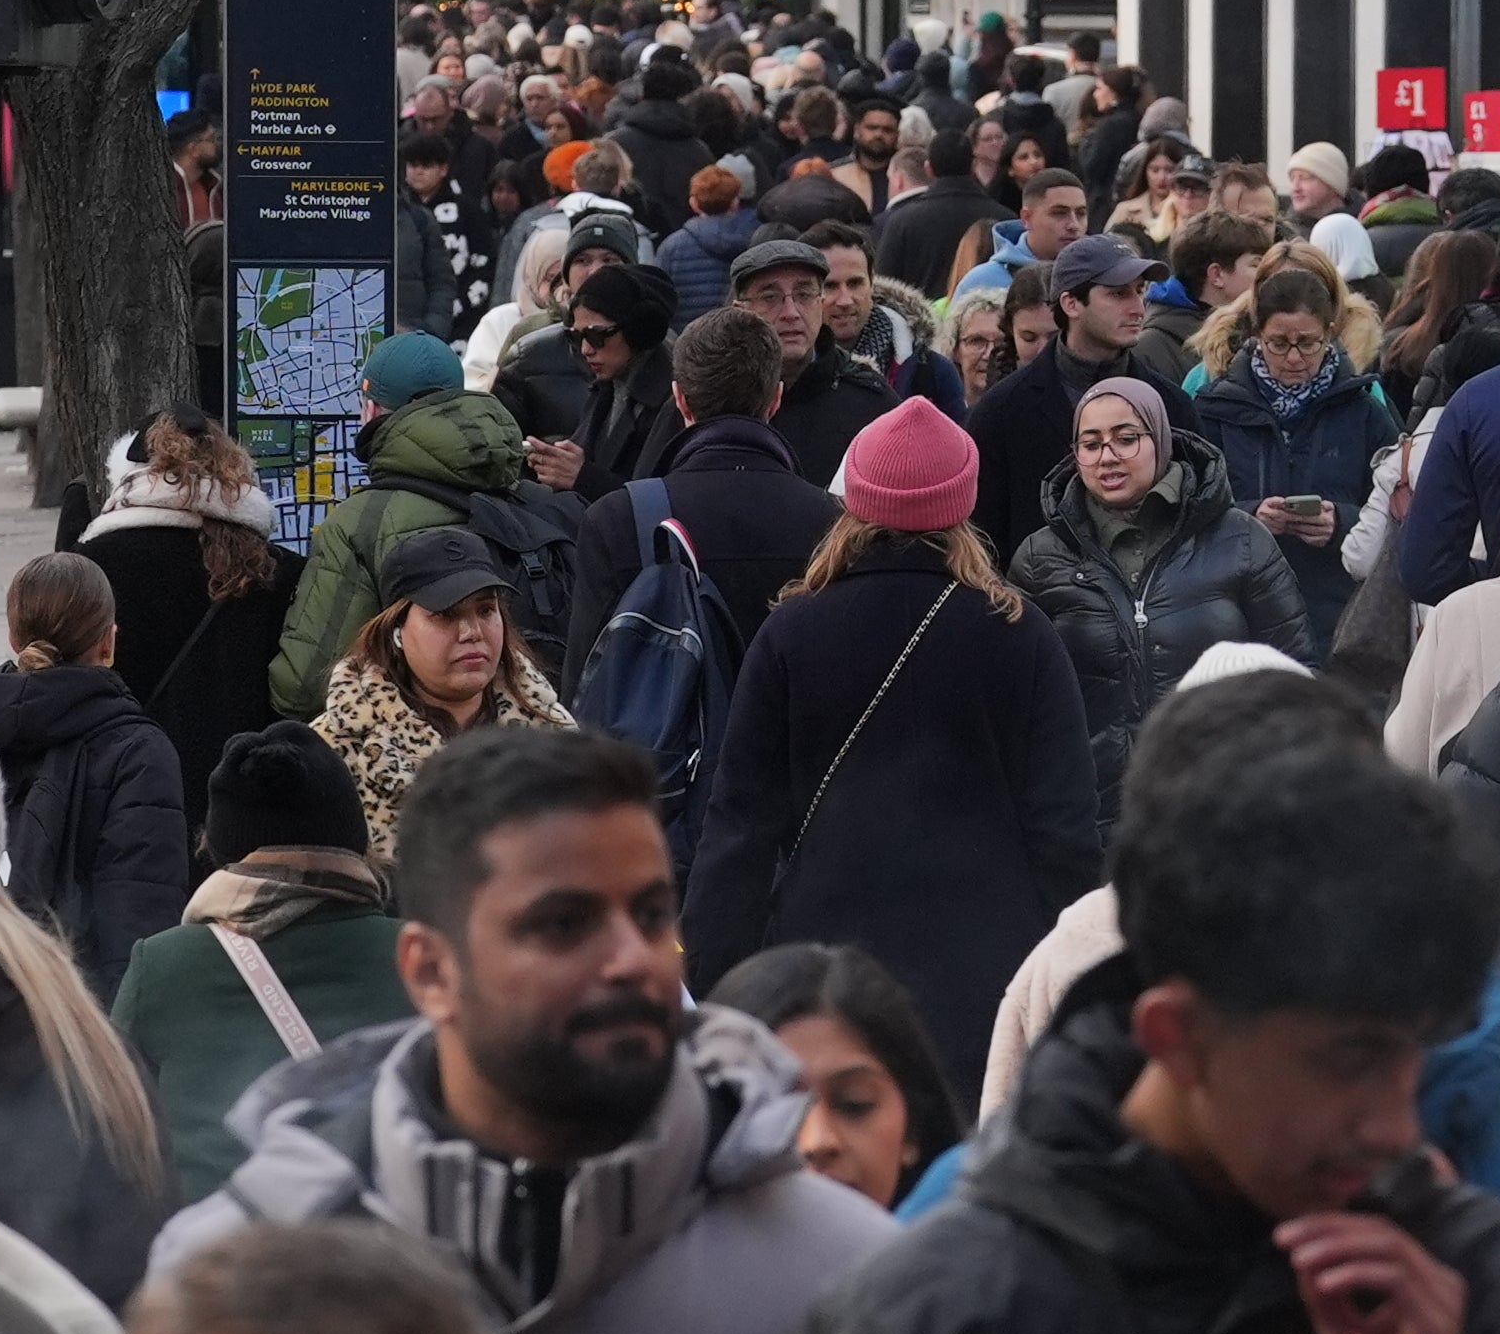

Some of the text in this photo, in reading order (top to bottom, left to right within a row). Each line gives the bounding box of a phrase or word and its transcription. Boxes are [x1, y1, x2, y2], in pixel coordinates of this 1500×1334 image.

[250, 83, 316, 93] HYDE PARK
[250, 97, 329, 107] PADDINGTON
[1395, 79, 1426, 116] £1
[251, 110, 301, 120] Portman
[251, 124, 321, 134] Marble Arch
[250, 146, 301, 155] MAYFAIR
[250, 159, 312, 169] Grosvenor
[291, 182, 370, 191] MARYLEBONE
[284, 195, 370, 207] St Christopher
[260, 208, 371, 221] Marylebone Village
